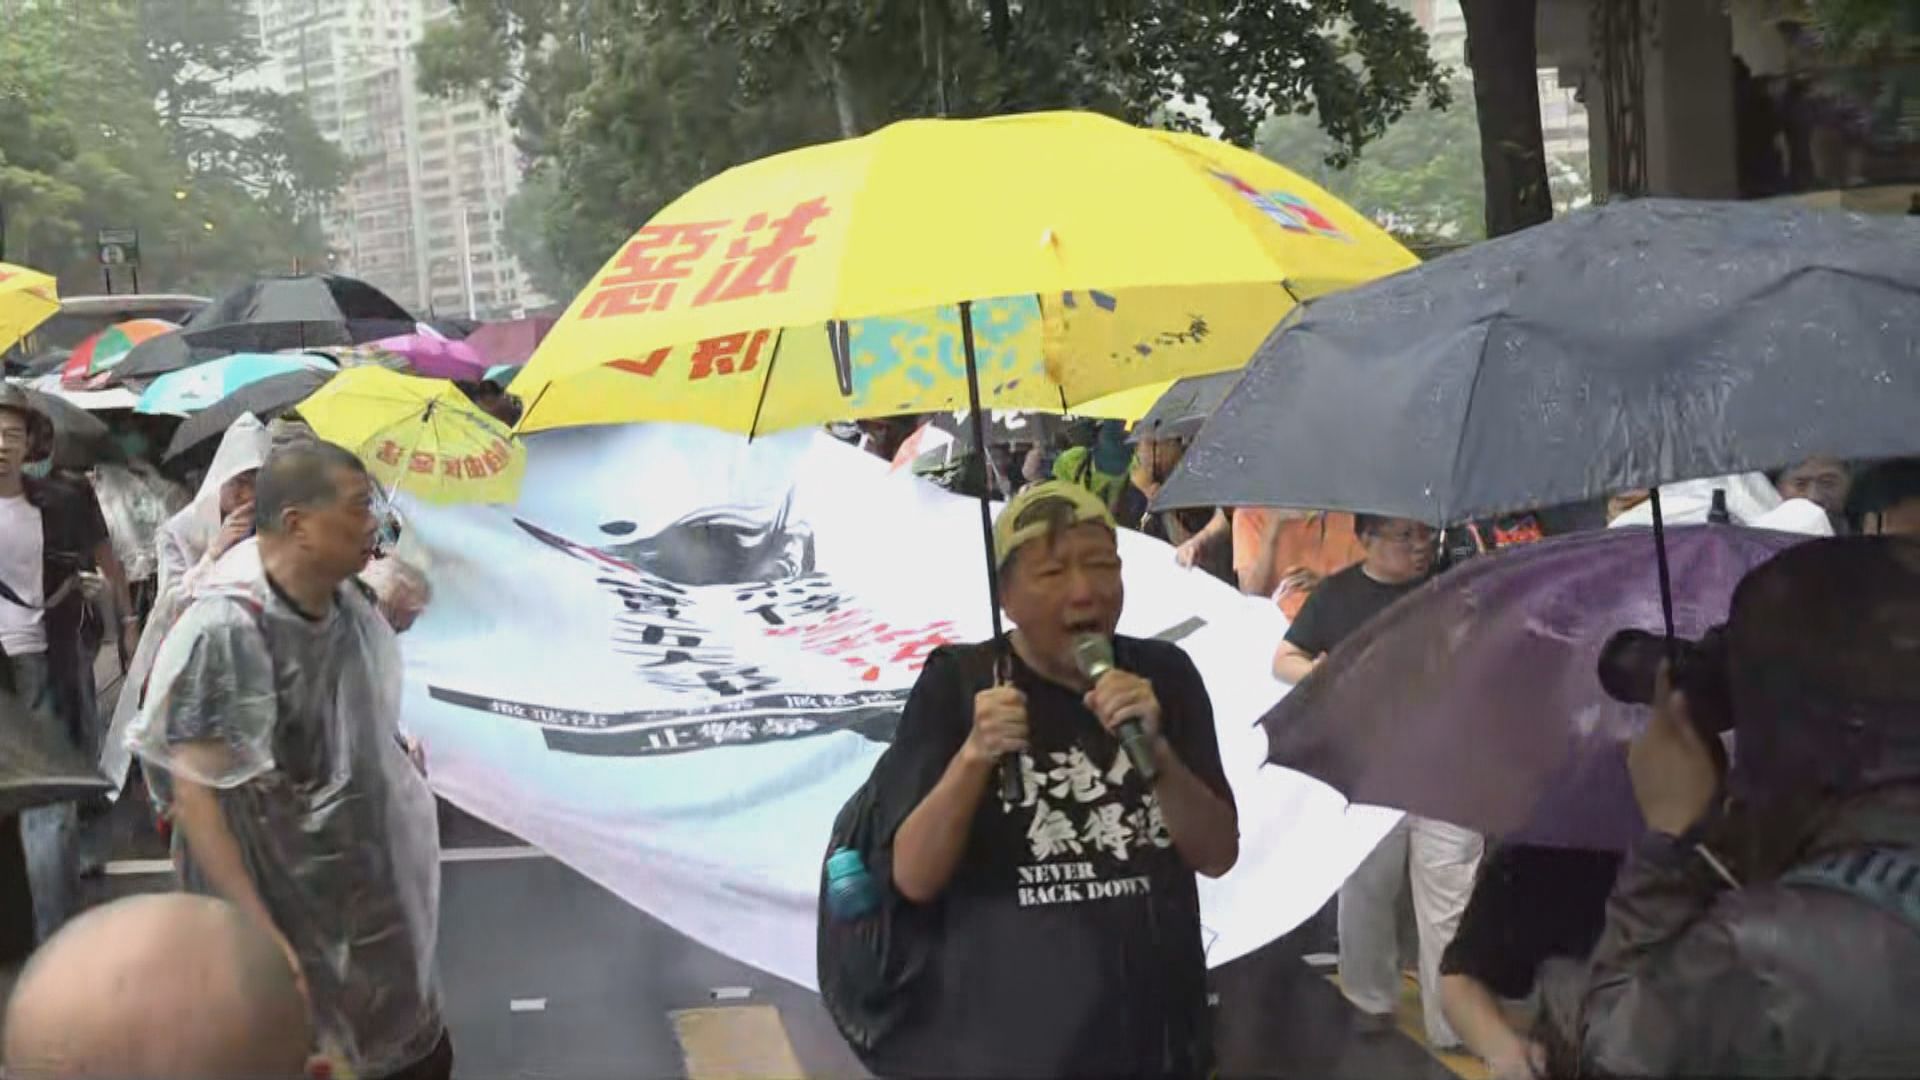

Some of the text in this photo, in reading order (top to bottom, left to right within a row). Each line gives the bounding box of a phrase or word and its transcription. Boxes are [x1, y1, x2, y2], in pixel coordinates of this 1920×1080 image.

[578, 196, 832, 320] 惡法
[1016, 861, 1097, 884] NEVER
[1018, 875, 1152, 907] BACK DOWN
